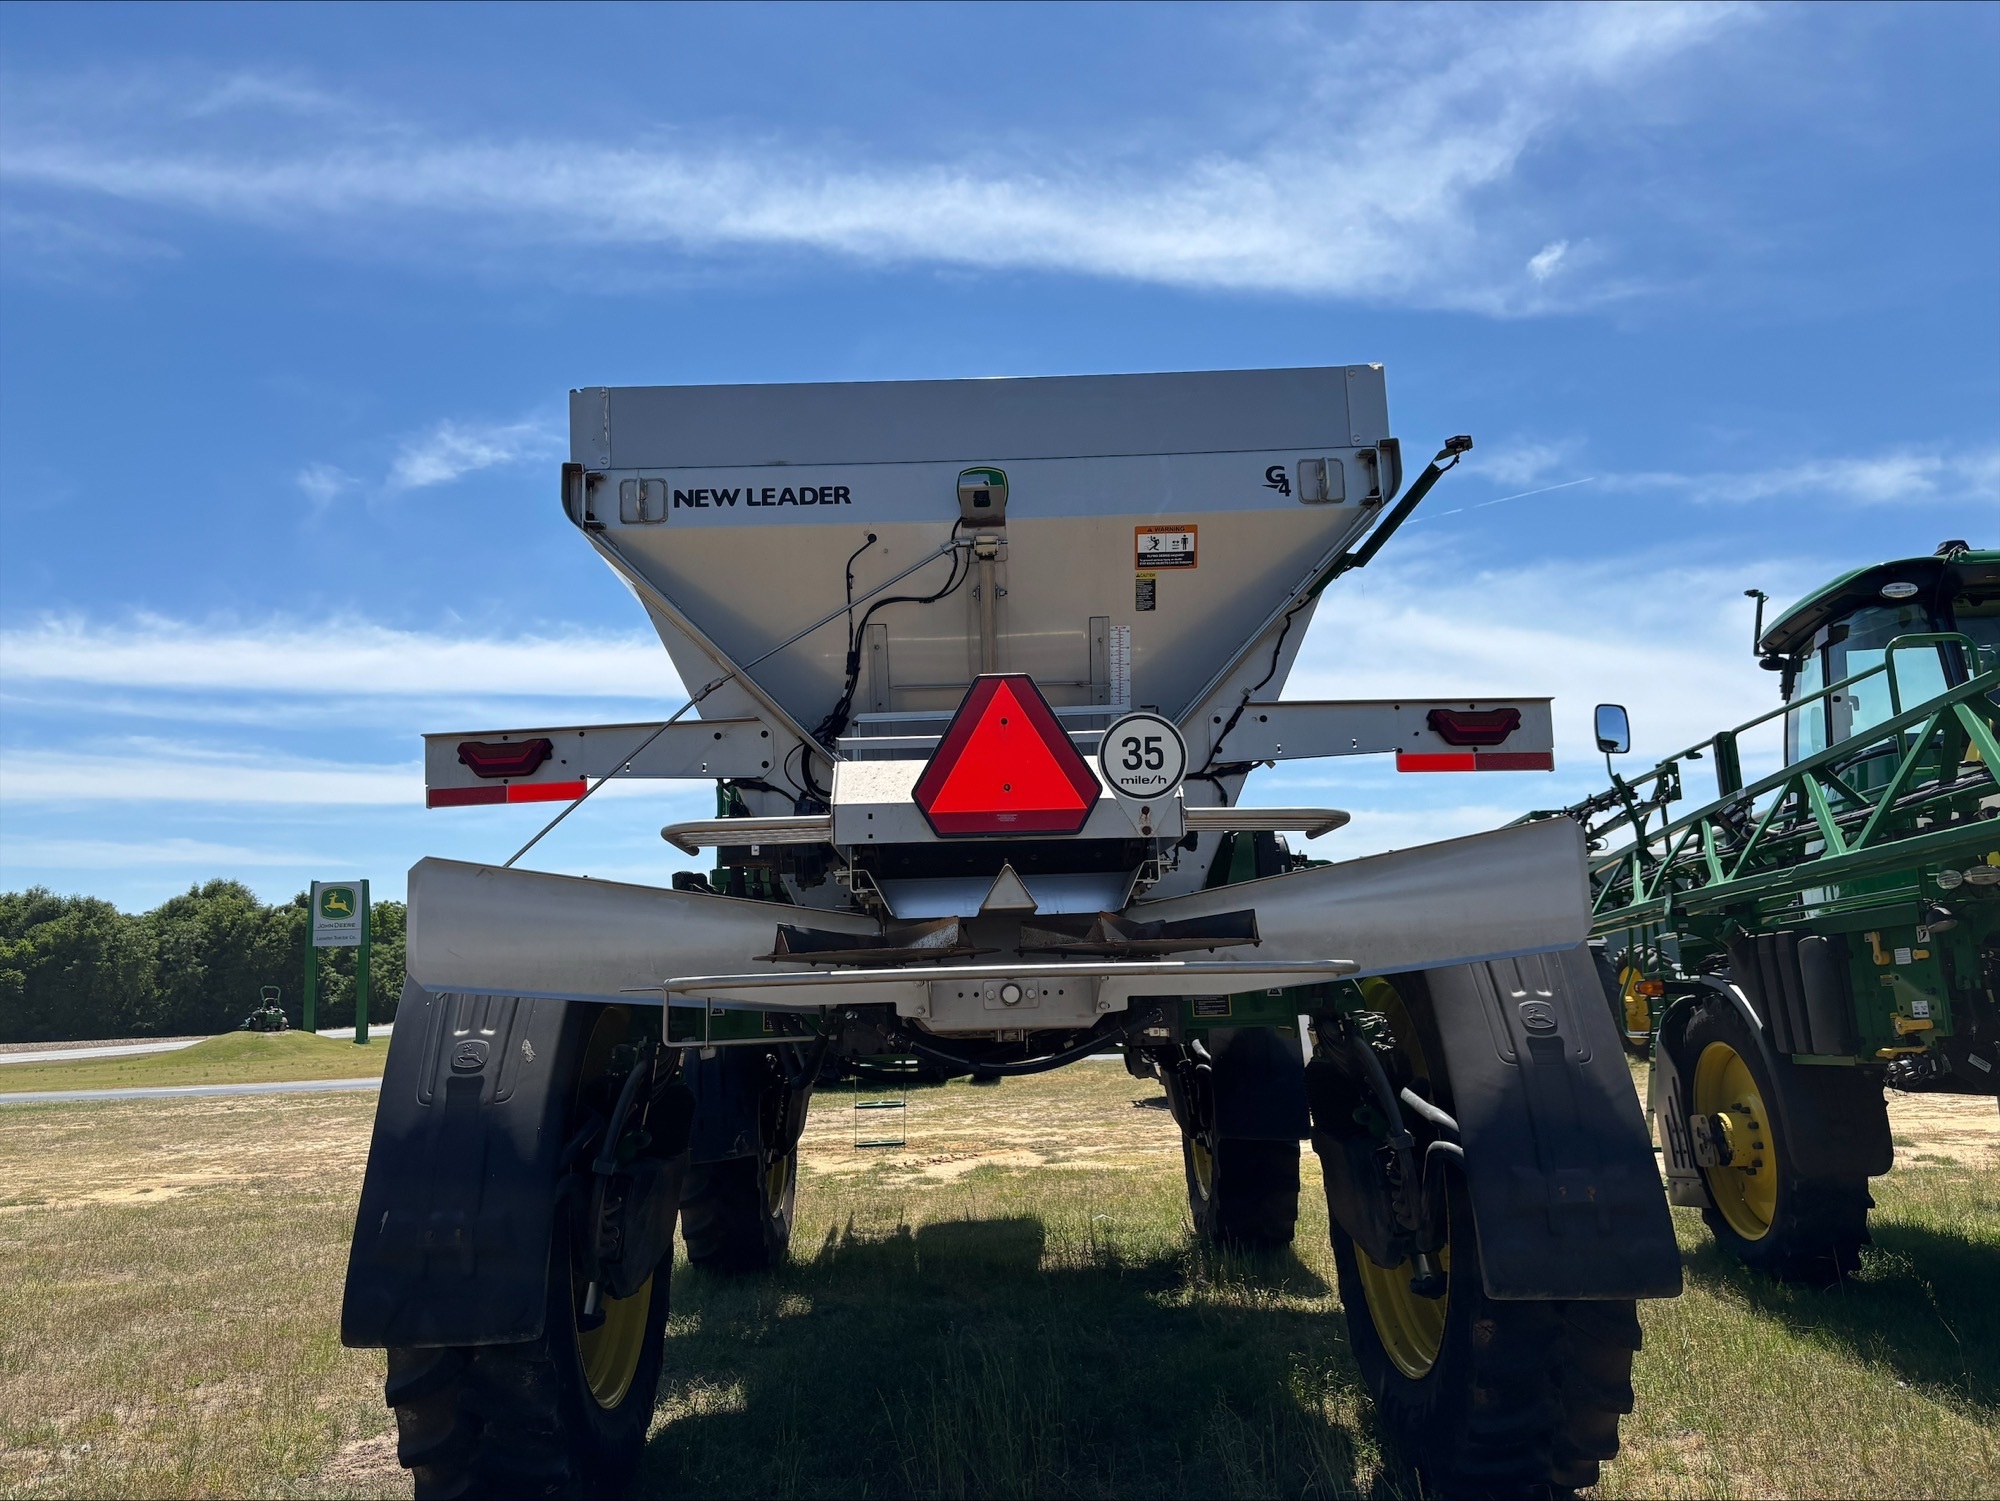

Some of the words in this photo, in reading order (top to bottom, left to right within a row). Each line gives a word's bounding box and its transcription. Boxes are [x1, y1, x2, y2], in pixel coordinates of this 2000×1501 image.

[673, 488, 741, 508] NEW
[746, 486, 852, 507] LEADER
[1121, 736, 1164, 770] 35
[1120, 775, 1167, 784] mile/h
